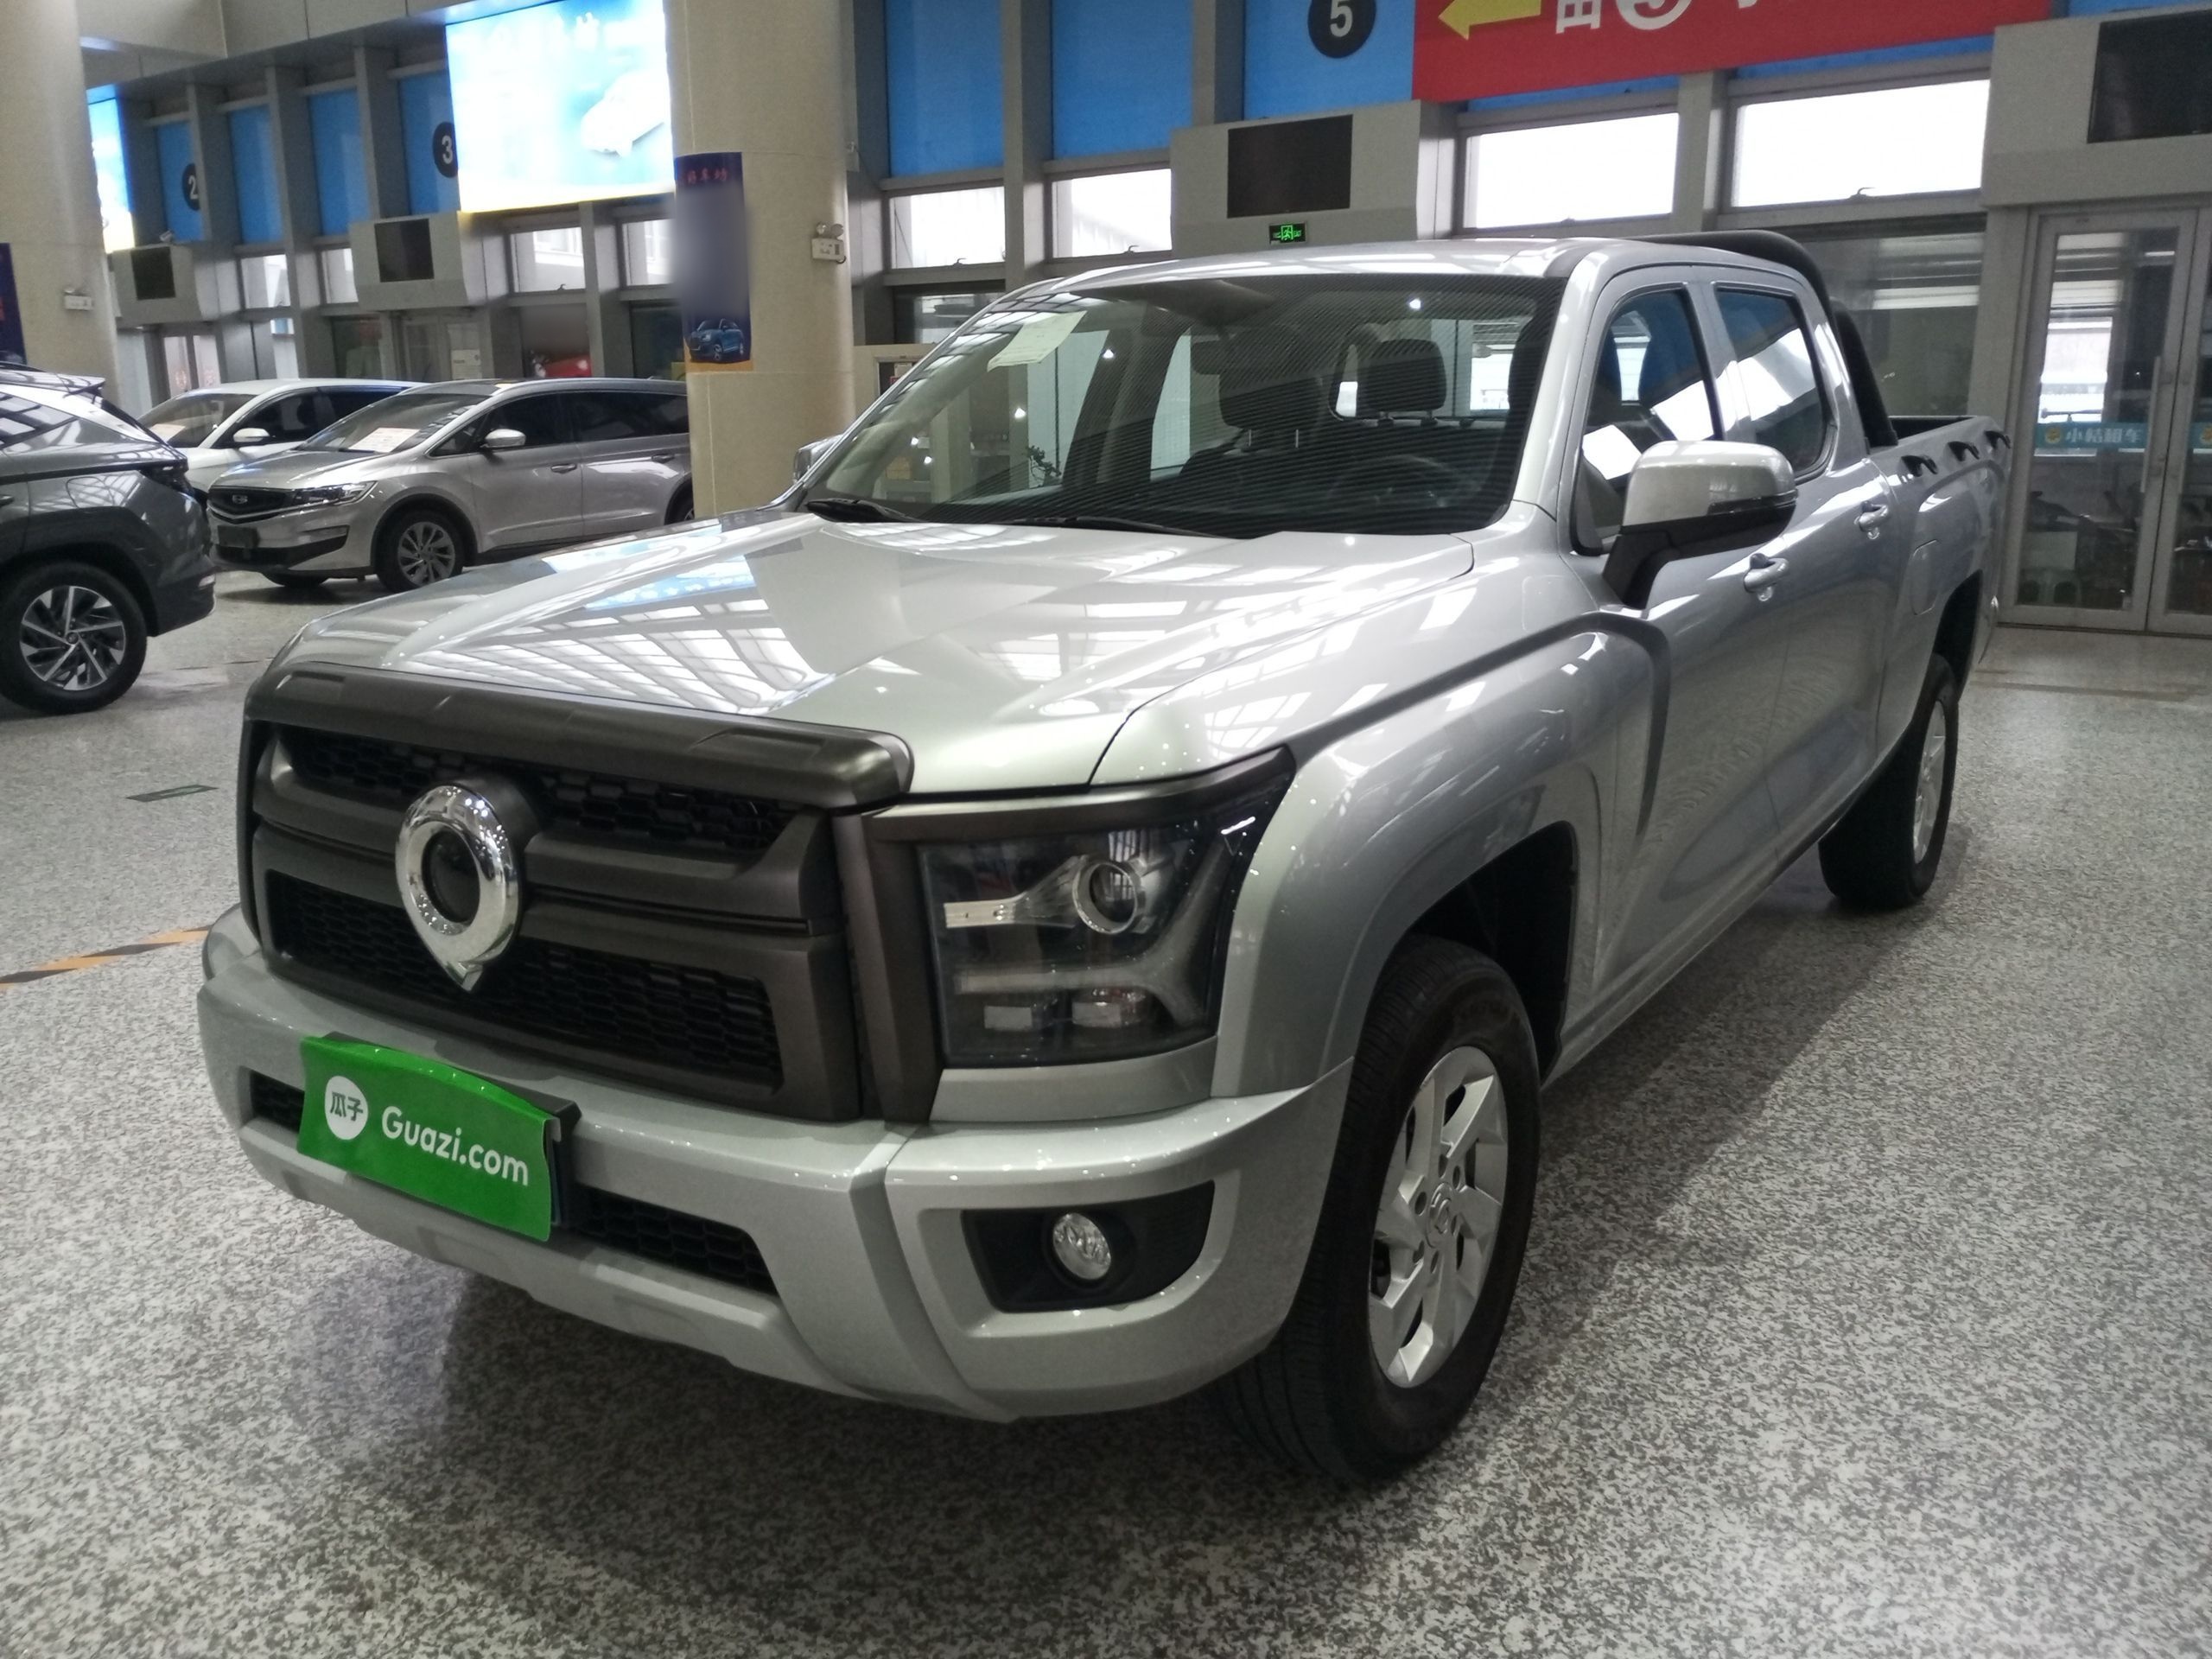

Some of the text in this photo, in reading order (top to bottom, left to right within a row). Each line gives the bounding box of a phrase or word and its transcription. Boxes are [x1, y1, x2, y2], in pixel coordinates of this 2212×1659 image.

[1331, 0, 1353, 37] 5
[442, 135, 454, 164] 3
[188, 175, 199, 200] 2
[329, 1091, 364, 1122] 瓜子
[381, 1105, 529, 1186] Guazi.com
